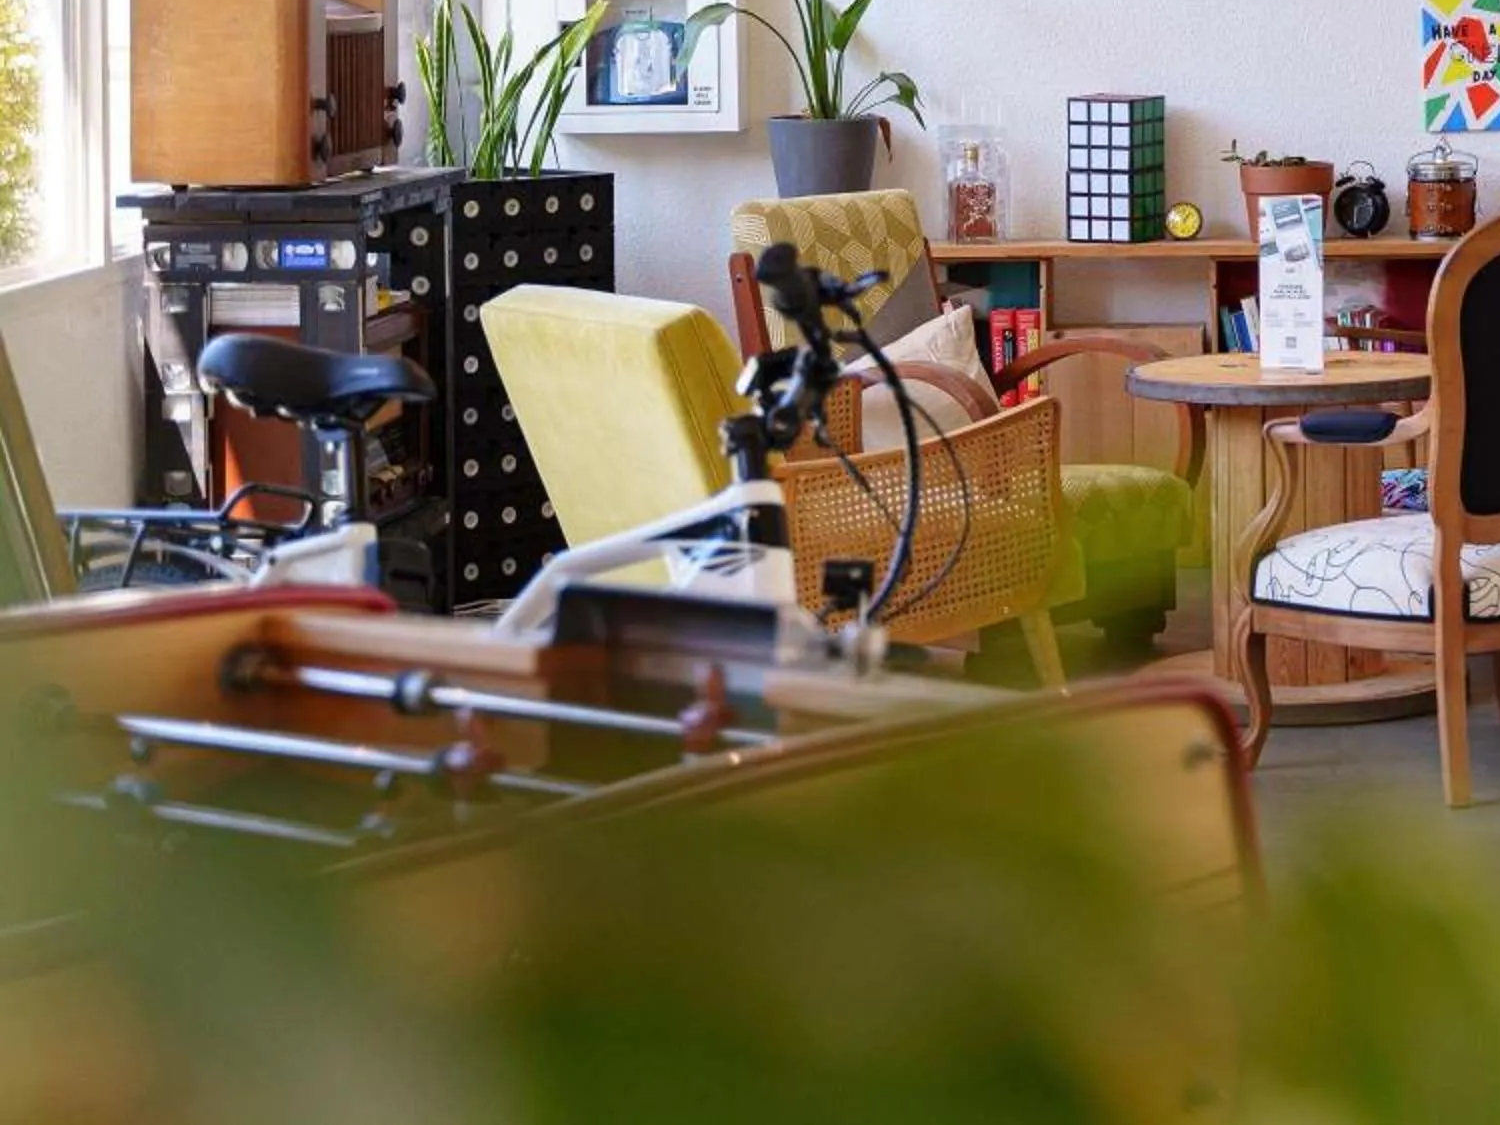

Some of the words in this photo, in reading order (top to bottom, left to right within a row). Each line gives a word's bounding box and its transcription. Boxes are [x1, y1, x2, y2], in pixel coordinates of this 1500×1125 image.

[1431, 24, 1469, 39] HAVE
[1489, 23, 1497, 35] A
[1473, 70, 1497, 82] DAY
